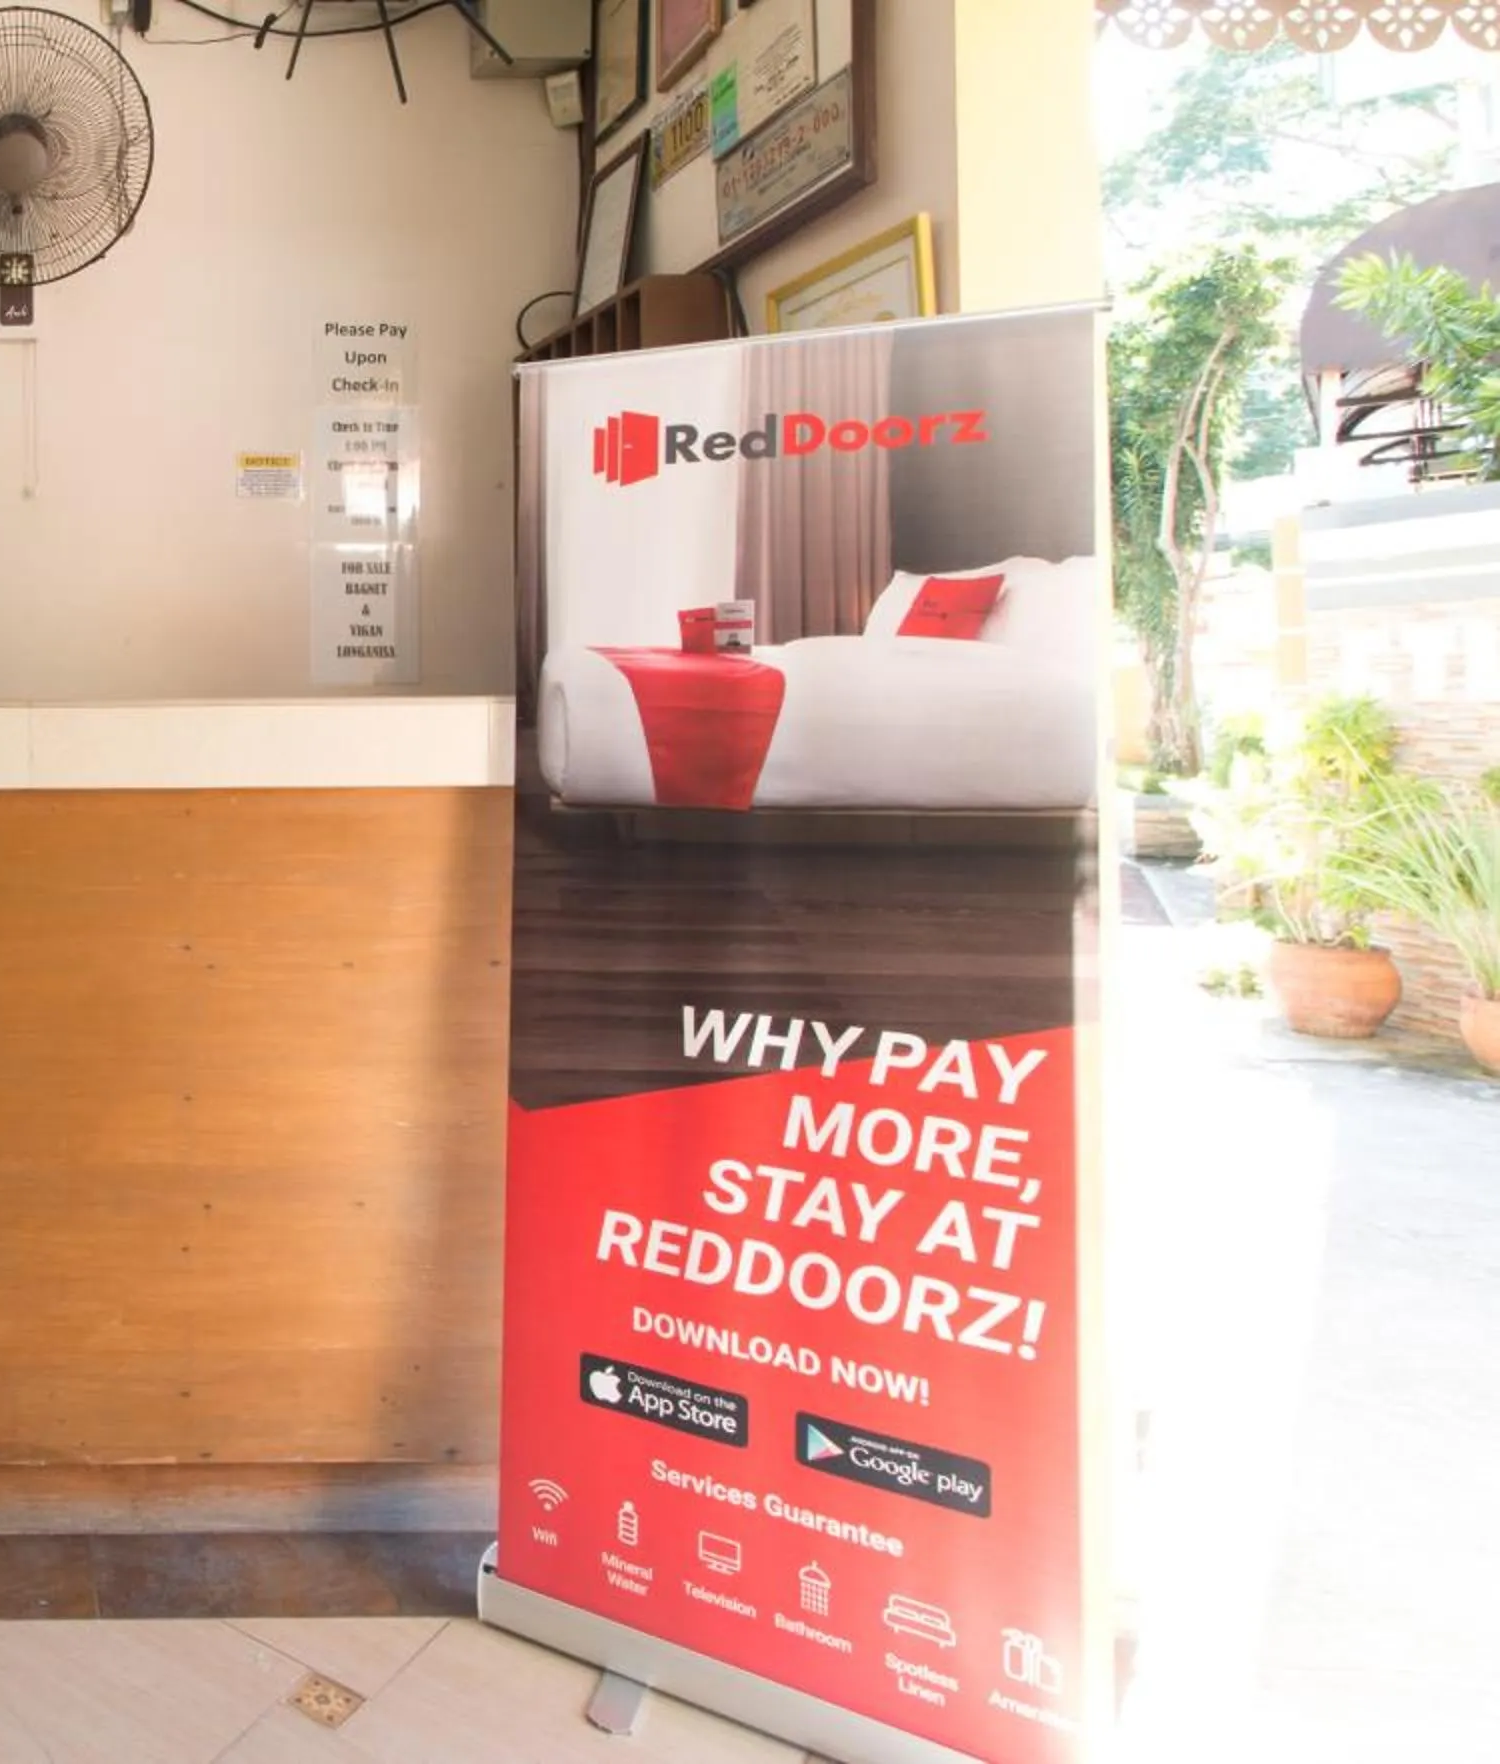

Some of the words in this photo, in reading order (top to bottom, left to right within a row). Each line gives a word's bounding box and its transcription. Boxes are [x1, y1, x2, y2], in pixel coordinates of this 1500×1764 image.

[325, 323, 374, 337] Please
[379, 323, 407, 339] Pay
[345, 351, 387, 366] Upon
[331, 378, 399, 393] Check-In
[665, 409, 988, 465] RedDoorz
[682, 1005, 865, 1078] WHY
[869, 1031, 1048, 1105] PAY
[782, 1095, 1042, 1203] MORE,
[703, 1159, 905, 1243] STAY
[916, 1200, 1041, 1271] AT
[596, 1210, 1047, 1361] REDDOORZ!
[632, 1306, 821, 1376] DOWNLOAD
[831, 1360, 930, 1407] NOW!
[627, 1370, 691, 1398] Download
[694, 1390, 711, 1405] on
[712, 1393, 738, 1412] the
[627, 1385, 674, 1418] App
[678, 1400, 738, 1434] Store
[849, 1446, 933, 1486] Google
[936, 1472, 984, 1503] play
[650, 1459, 757, 1512] Services
[763, 1493, 905, 1557] Guarantee
[601, 1551, 654, 1582] Mineral
[607, 1569, 650, 1597] Water
[683, 1579, 758, 1619] Television
[774, 1612, 852, 1654] Bathroom
[883, 1651, 960, 1693] Spotless
[898, 1674, 946, 1707] Linen
